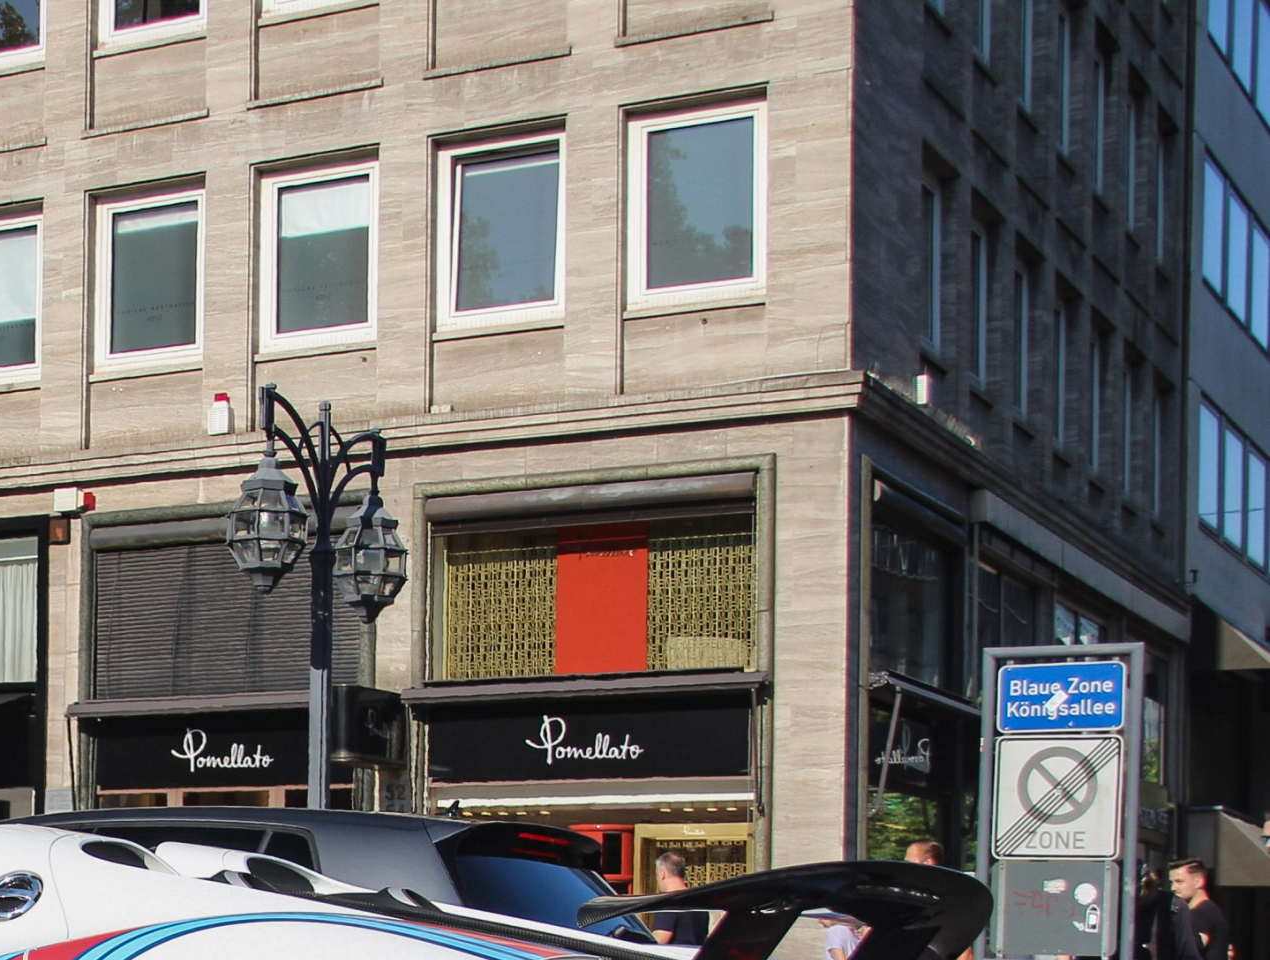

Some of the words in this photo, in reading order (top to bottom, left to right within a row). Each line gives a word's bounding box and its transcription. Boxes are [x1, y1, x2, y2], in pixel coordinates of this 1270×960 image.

[1009, 680, 1061, 696] Blaue
[1067, 677, 1113, 694] Zone
[525, 715, 644, 765] Pomellato
[170, 728, 275, 772] Pomellato
[385, 783, 406, 801] 52
[1024, 831, 1086, 850] ZONE
